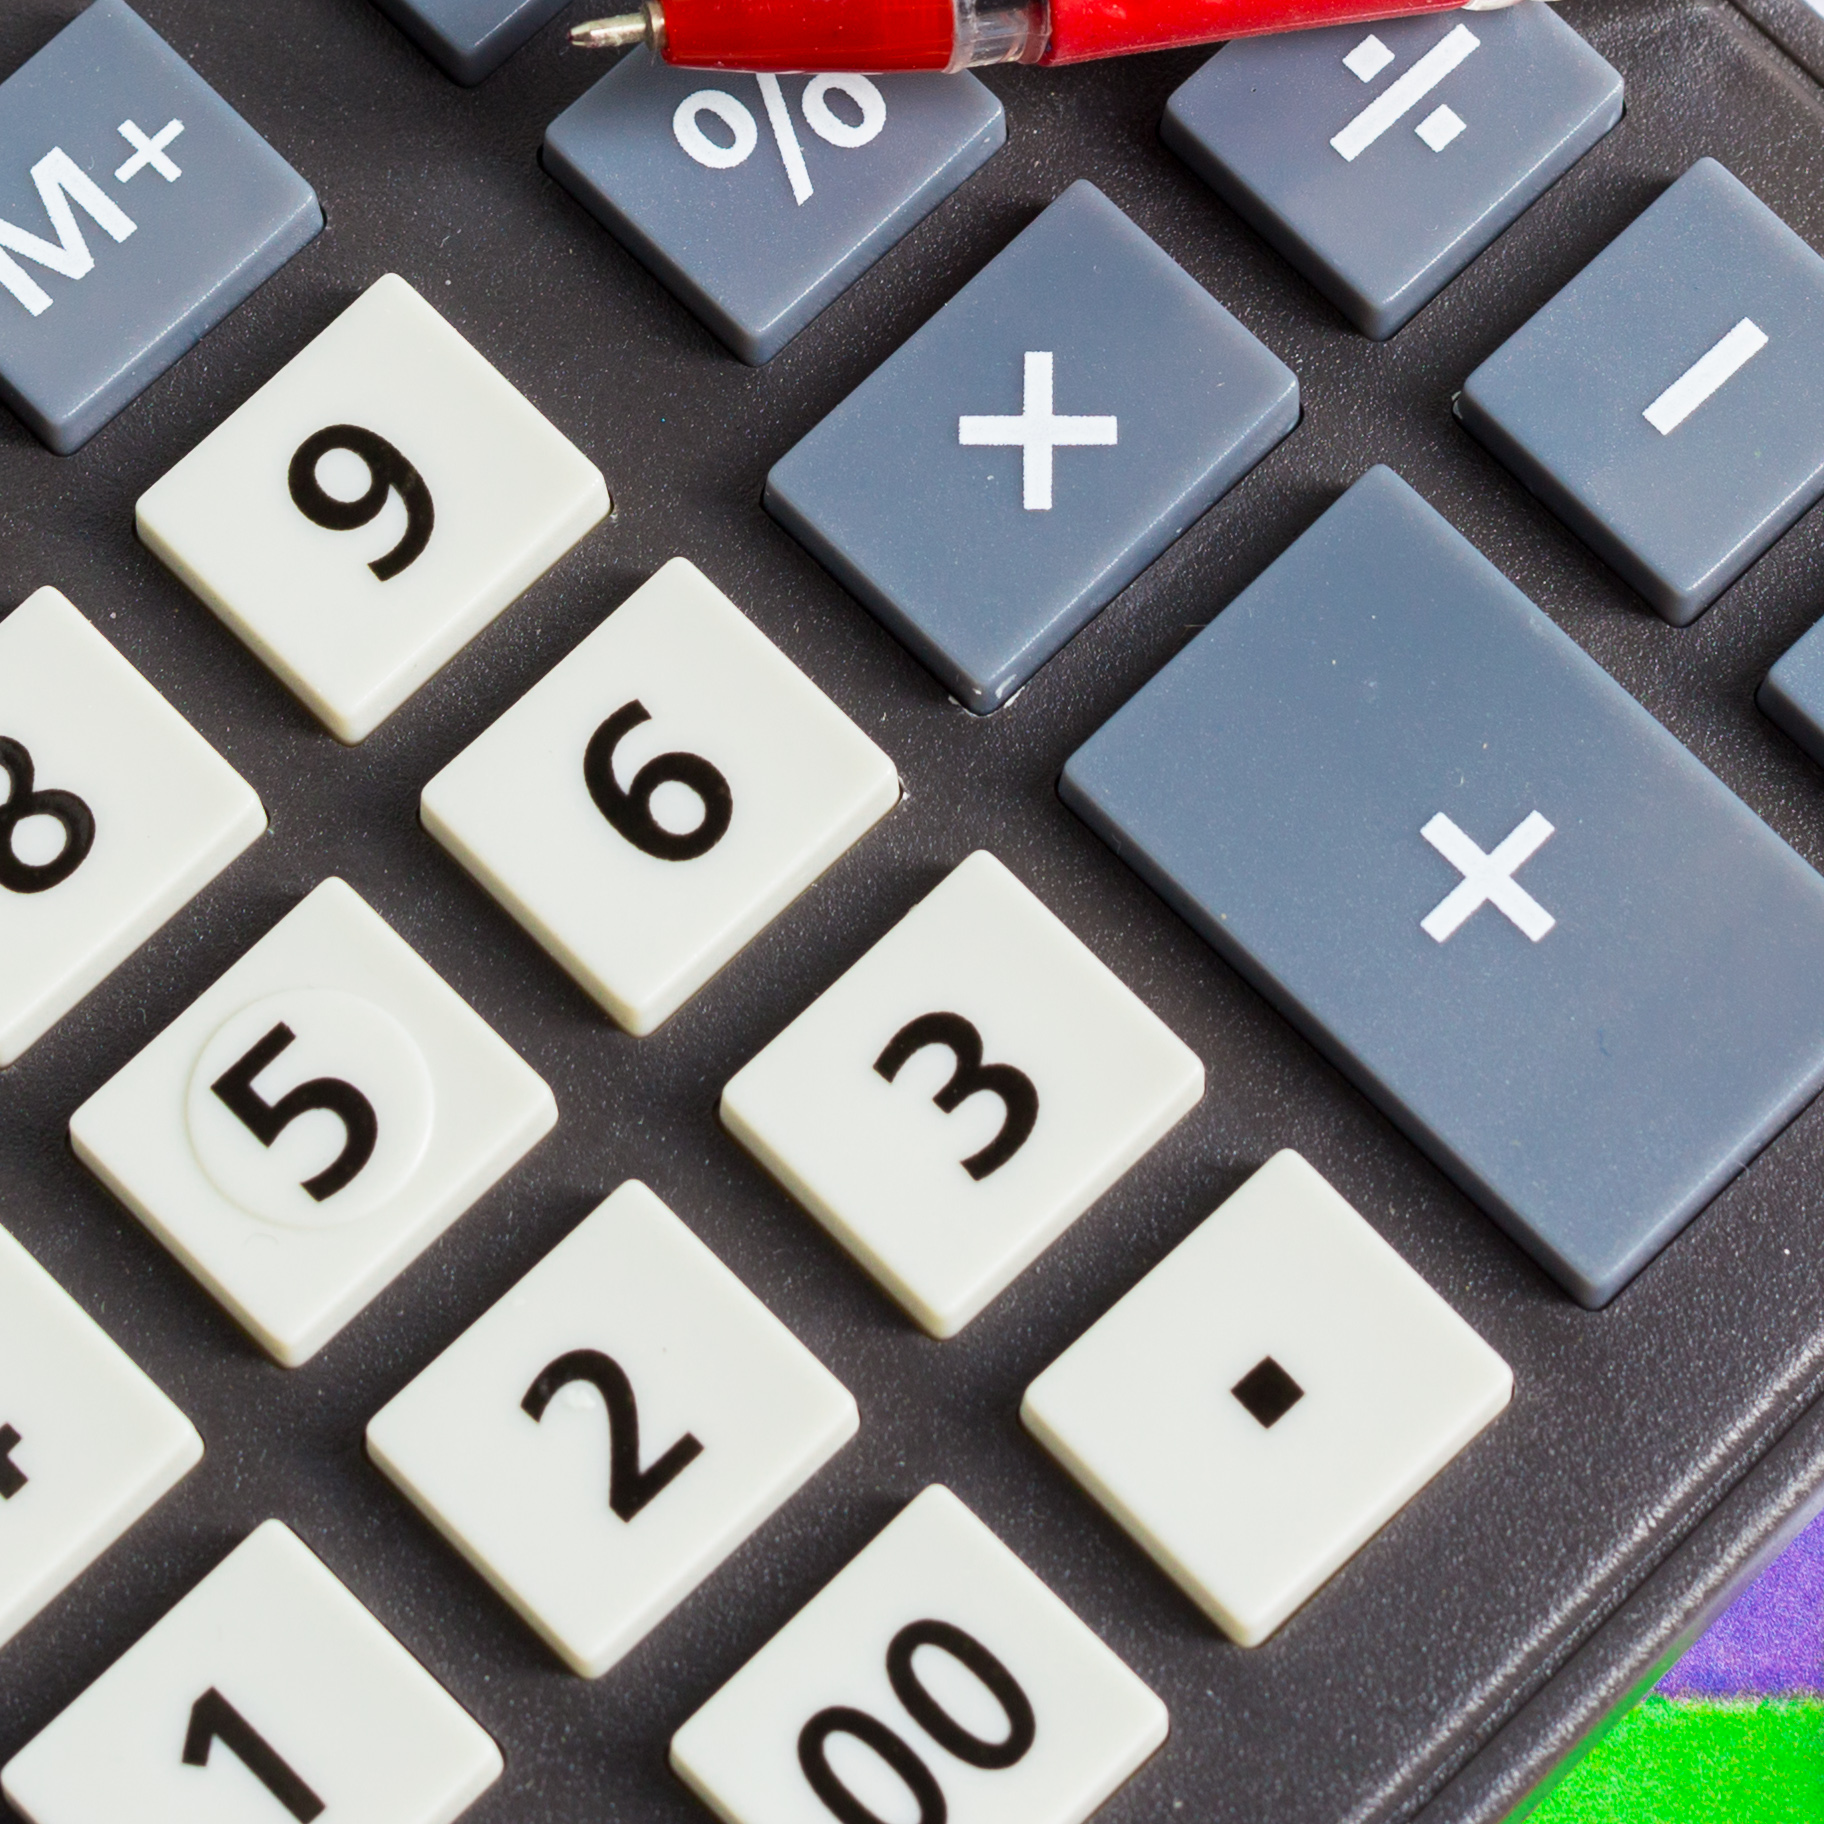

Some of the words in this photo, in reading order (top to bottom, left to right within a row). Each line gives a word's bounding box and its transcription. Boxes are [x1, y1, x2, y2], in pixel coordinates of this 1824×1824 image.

[288, 425, 434, 581] 9
[584, 700, 732, 861] 6
[211, 1023, 377, 1201] 5
[874, 1012, 1038, 1180] 3
[521, 1350, 703, 1522] 2
[183, 1688, 324, 1824] 1
[797, 1618, 1036, 1824] 00
